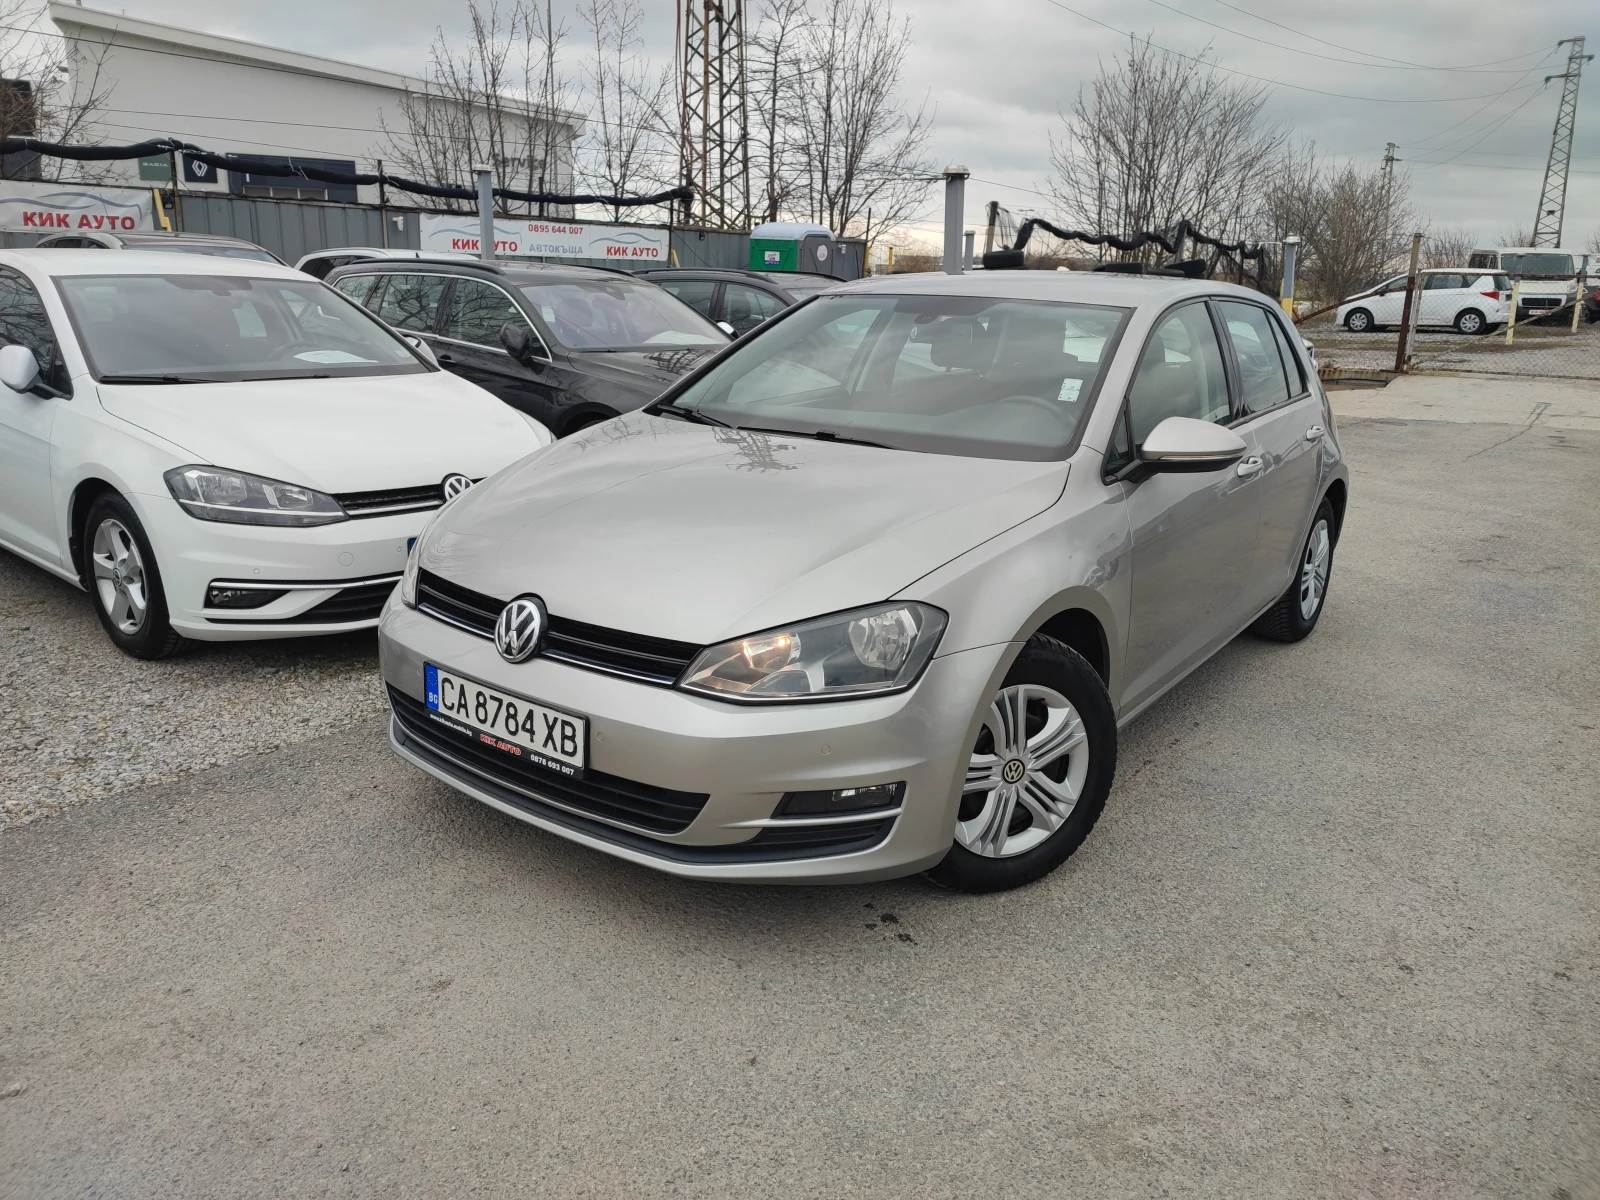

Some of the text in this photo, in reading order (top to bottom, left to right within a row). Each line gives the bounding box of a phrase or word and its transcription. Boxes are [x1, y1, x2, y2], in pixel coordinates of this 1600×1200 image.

[22, 211, 136, 230] КИК АУТО
[528, 224, 584, 235] 0895 644 007
[452, 238, 518, 253] КИК УТО
[529, 243, 584, 255] АВТОКЪЩА
[606, 246, 658, 258] КИК АУТО
[428, 691, 438, 704] BG
[441, 677, 578, 758] CA 8784 XB
[497, 741, 521, 756] AUTO
[530, 753, 547, 766] 0878
[561, 765, 575, 776] 007
